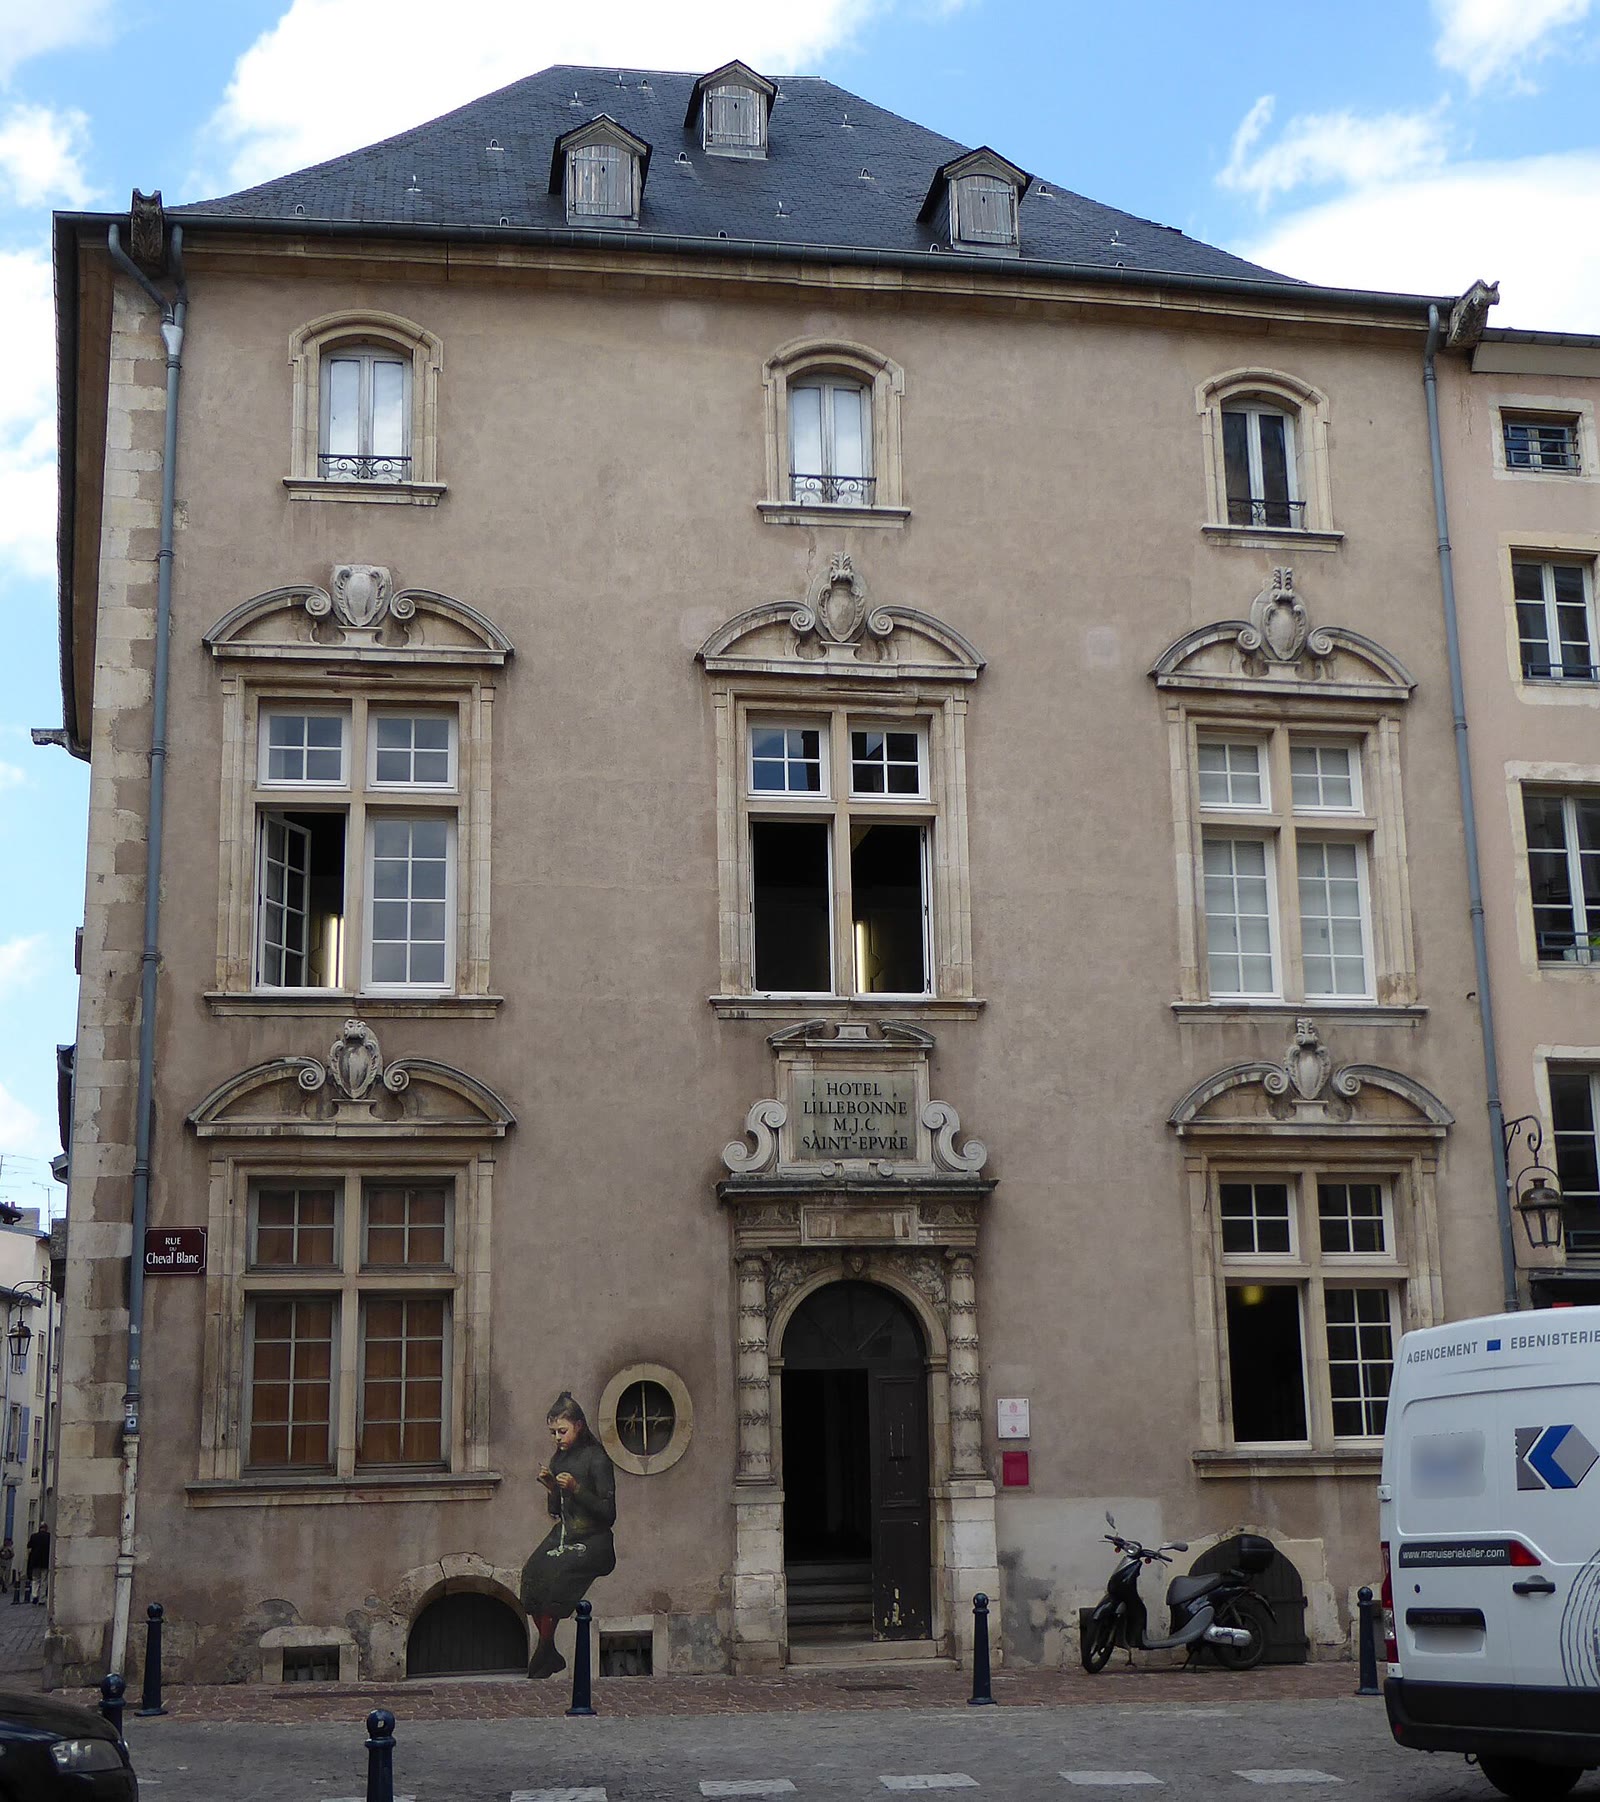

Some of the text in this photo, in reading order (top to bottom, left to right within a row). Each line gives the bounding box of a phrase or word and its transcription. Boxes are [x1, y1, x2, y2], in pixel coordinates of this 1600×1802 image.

[826, 1082, 881, 1096] HOTEL
[803, 1101, 907, 1115] LILLEBONNE
[833, 1117, 880, 1135] M.J.C.
[802, 1136, 908, 1150] SAINT-EPVRE
[165, 1237, 181, 1245] RUE
[146, 1251, 199, 1265] Cheval Blanc
[1407, 1330, 1600, 1364] AGENCEMENT EBENISTERIE
[1402, 1548, 1505, 1559] www.menuiseriekeller.com
